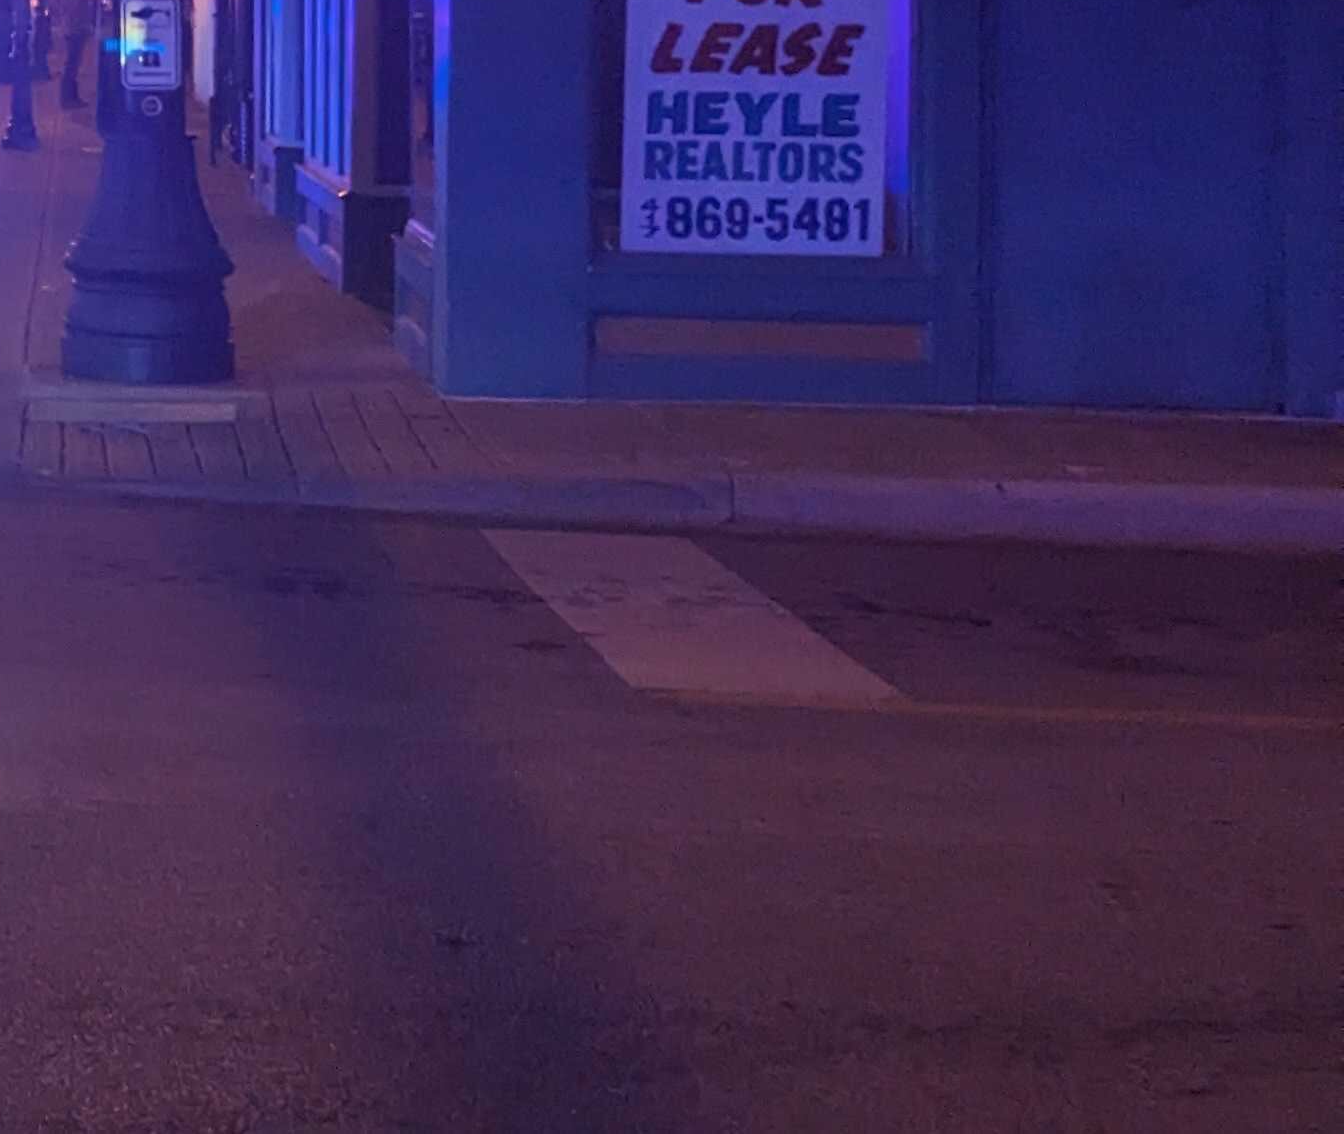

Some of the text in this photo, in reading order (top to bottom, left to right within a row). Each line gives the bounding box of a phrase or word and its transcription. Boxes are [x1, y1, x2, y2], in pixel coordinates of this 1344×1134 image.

[650, 22, 865, 77] LEASE
[646, 90, 861, 138] HEYLE
[643, 140, 865, 184] REALTORS
[665, 196, 871, 241] 869-5481
